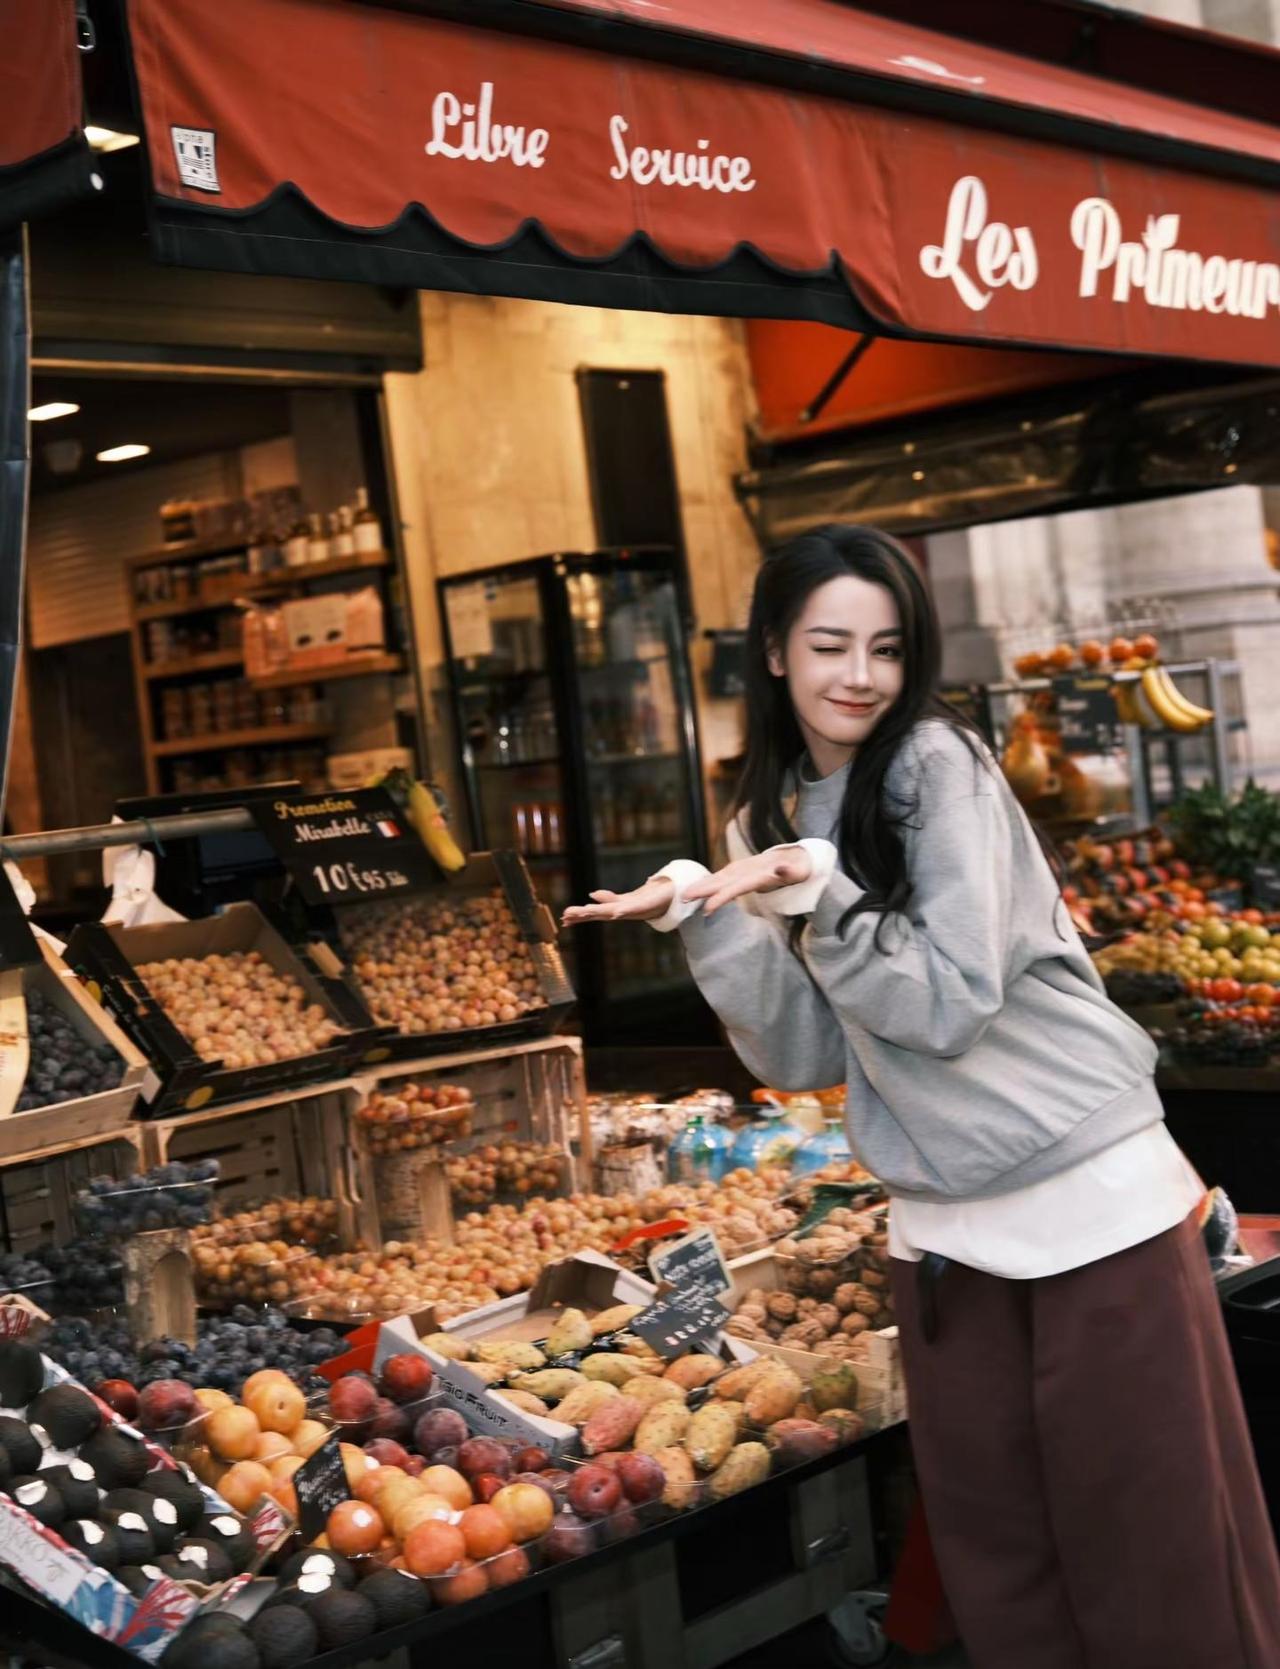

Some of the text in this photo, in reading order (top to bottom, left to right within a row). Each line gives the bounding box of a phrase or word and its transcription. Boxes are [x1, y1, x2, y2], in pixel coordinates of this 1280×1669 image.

[425, 82, 756, 194] Libre Service
[919, 175, 1039, 312] Les
[294, 817, 371, 843] Mirabelle
